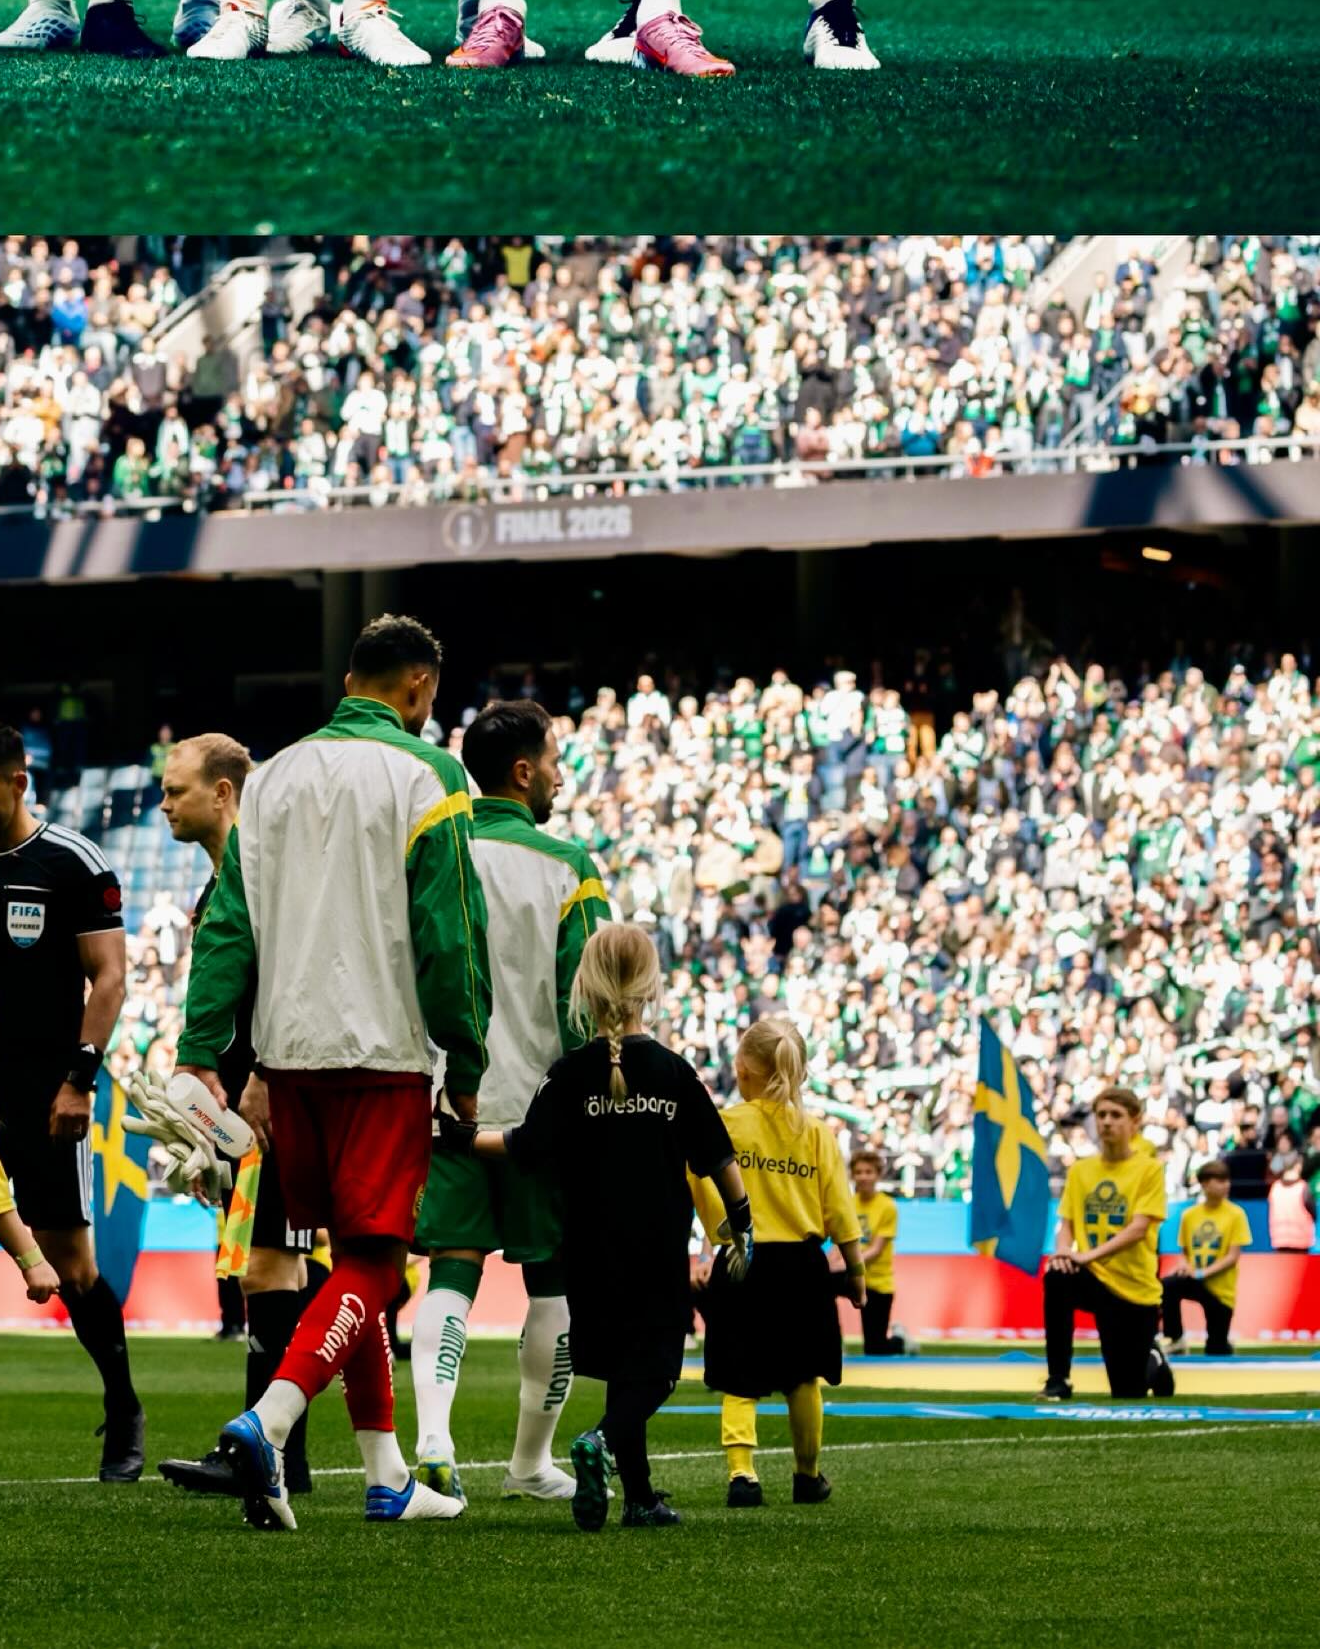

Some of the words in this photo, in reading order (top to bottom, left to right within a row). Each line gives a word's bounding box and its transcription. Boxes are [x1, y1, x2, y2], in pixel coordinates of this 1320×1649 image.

[495, 509, 564, 545] FINAL
[566, 505, 632, 540] 2026
[11, 905, 41, 918] FIFA
[10, 923, 41, 931] REFEREE
[584, 1094, 678, 1121] ölvesborg
[316, 1293, 366, 1363] Clinton
